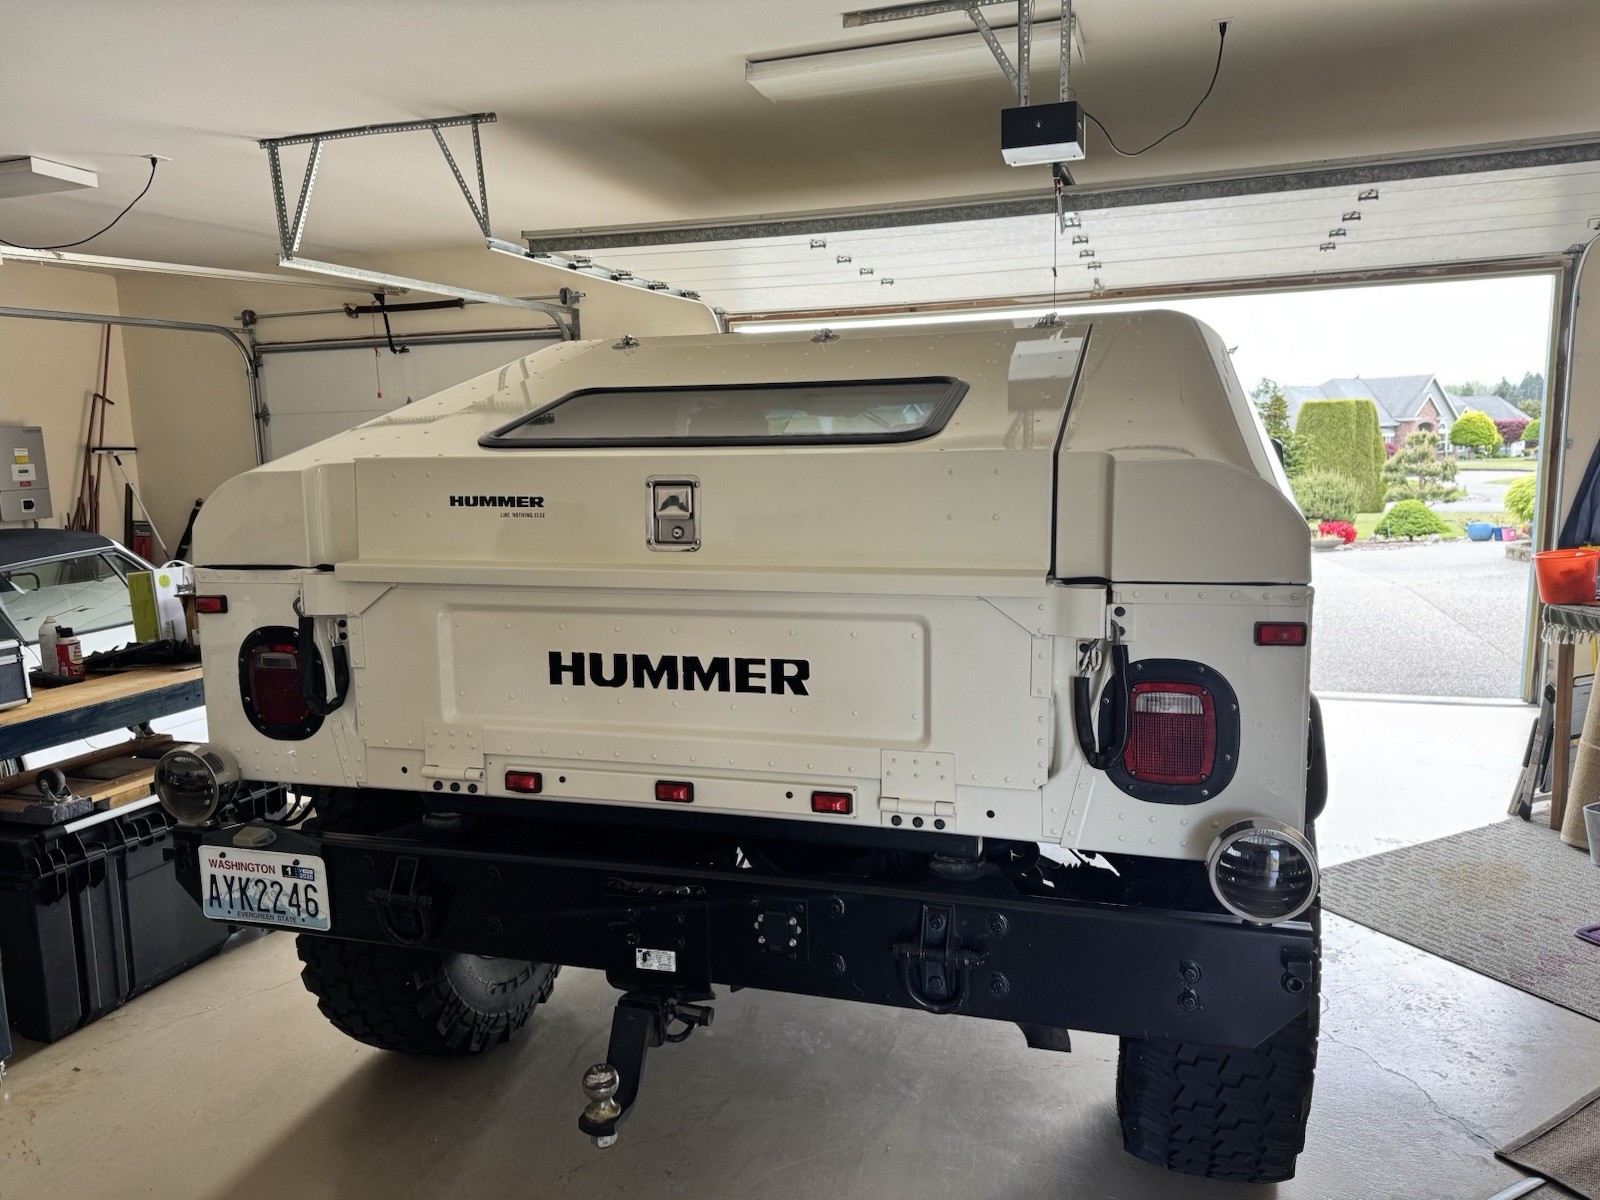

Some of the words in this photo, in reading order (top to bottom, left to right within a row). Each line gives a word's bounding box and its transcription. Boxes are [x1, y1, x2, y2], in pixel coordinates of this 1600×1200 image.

[449, 495, 545, 508] HUMMER
[549, 651, 810, 696] HUMMER
[208, 859, 276, 875] WASHINGTON
[209, 874, 319, 918] AYK2246
[237, 911, 275, 921] EVERGREEN
[277, 915, 298, 924] STATE
